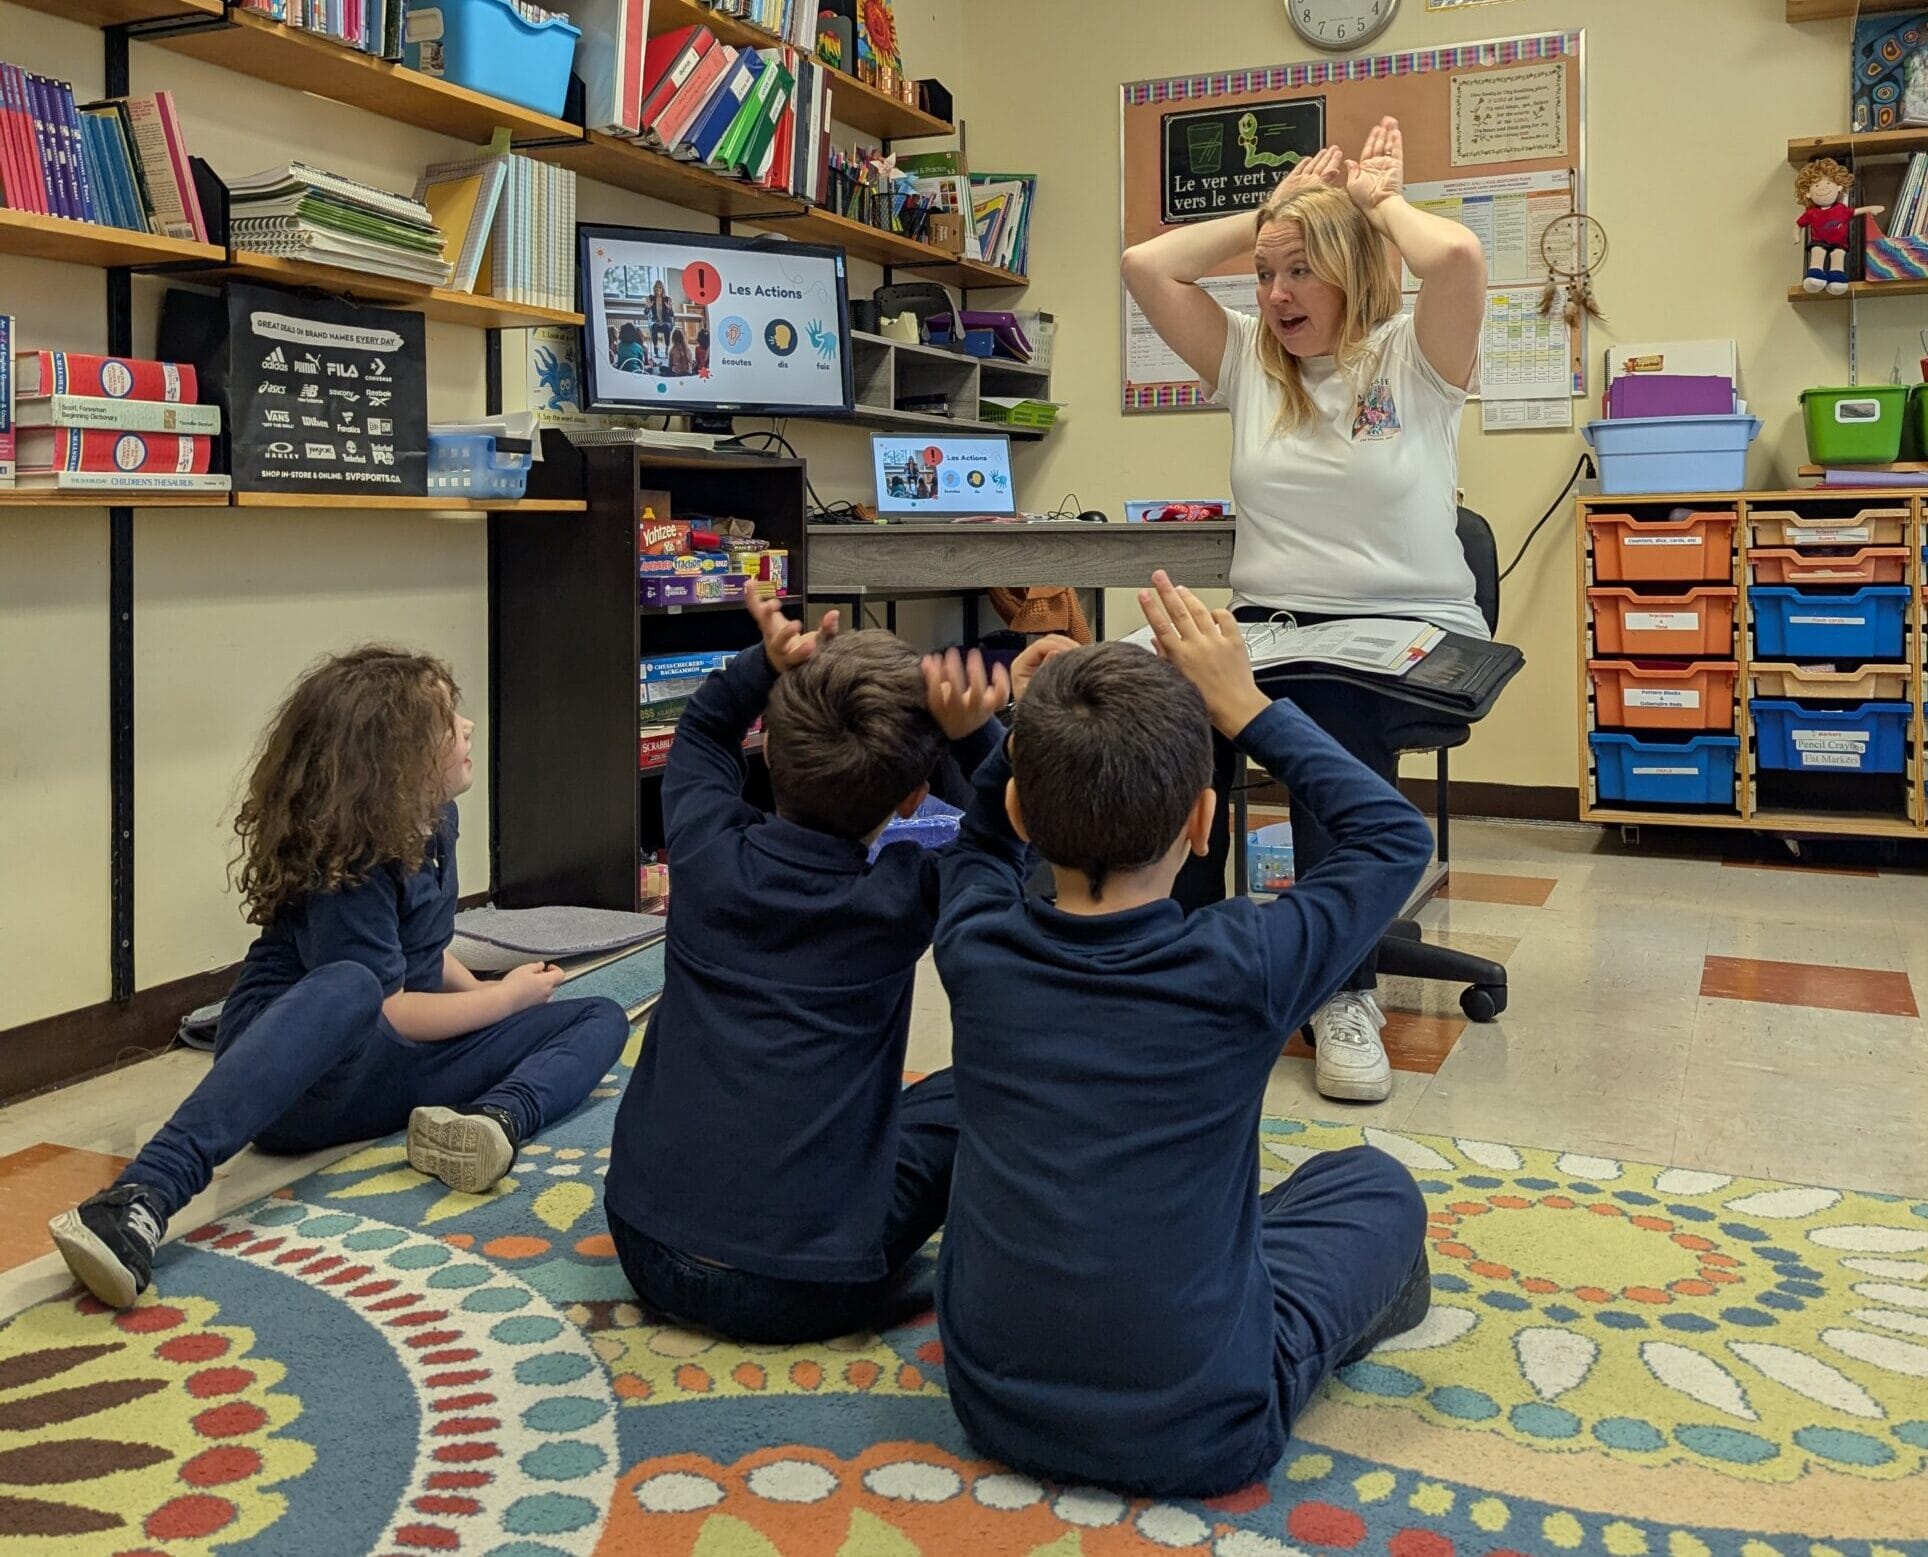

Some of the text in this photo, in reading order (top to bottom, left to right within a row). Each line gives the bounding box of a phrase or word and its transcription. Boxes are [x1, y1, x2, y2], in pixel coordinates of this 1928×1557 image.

[1371, 1, 1380, 15] 4
[1303, 9, 1311, 23] 8
[1318, 20, 1326, 36] 7
[1357, 17, 1366, 32] 5
[1337, 24, 1346, 39] 6
[1174, 175, 1196, 193] Le
[1201, 176, 1228, 190] ver
[1233, 169, 1266, 187] vert
[1174, 196, 1206, 210] vers
[1212, 190, 1226, 207] le
[729, 282, 803, 300] Les Actions
[257, 319, 395, 346] GREAT DEALS ON BRAND NAMES EVERY DAY
[261, 361, 289, 372] adidas
[294, 360, 319, 375] PUMA
[721, 357, 752, 367] écoutes
[777, 361, 789, 369] dis
[816, 362, 830, 370] fais
[326, 362, 360, 378] FILA
[365, 375, 393, 383] CONVERSE
[365, 388, 392, 398] Reebok
[62, 404, 78, 413] Scott,
[62, 411, 118, 422] Beginning Dictionary
[265, 409, 290, 423] VANS
[301, 415, 330, 429] Wilson
[543, 413, 552, 422] Say
[552, 414, 560, 422] the
[337, 423, 361, 434] Fanatics
[111, 477, 152, 487] CHILDREN'S
[154, 478, 194, 487] THESAURUS
[261, 470, 280, 478] SHOP
[281, 471, 312, 479] IN-STORE
[345, 473, 401, 484] SVPSPORTS.CA
[643, 523, 677, 547] Yahtzee
[647, 590, 657, 598] 6+
[660, 666, 700, 676] BACKGAMMON
[1798, 741, 1864, 751] Pencil Crayons
[1821, 755, 1859, 764] Markers
